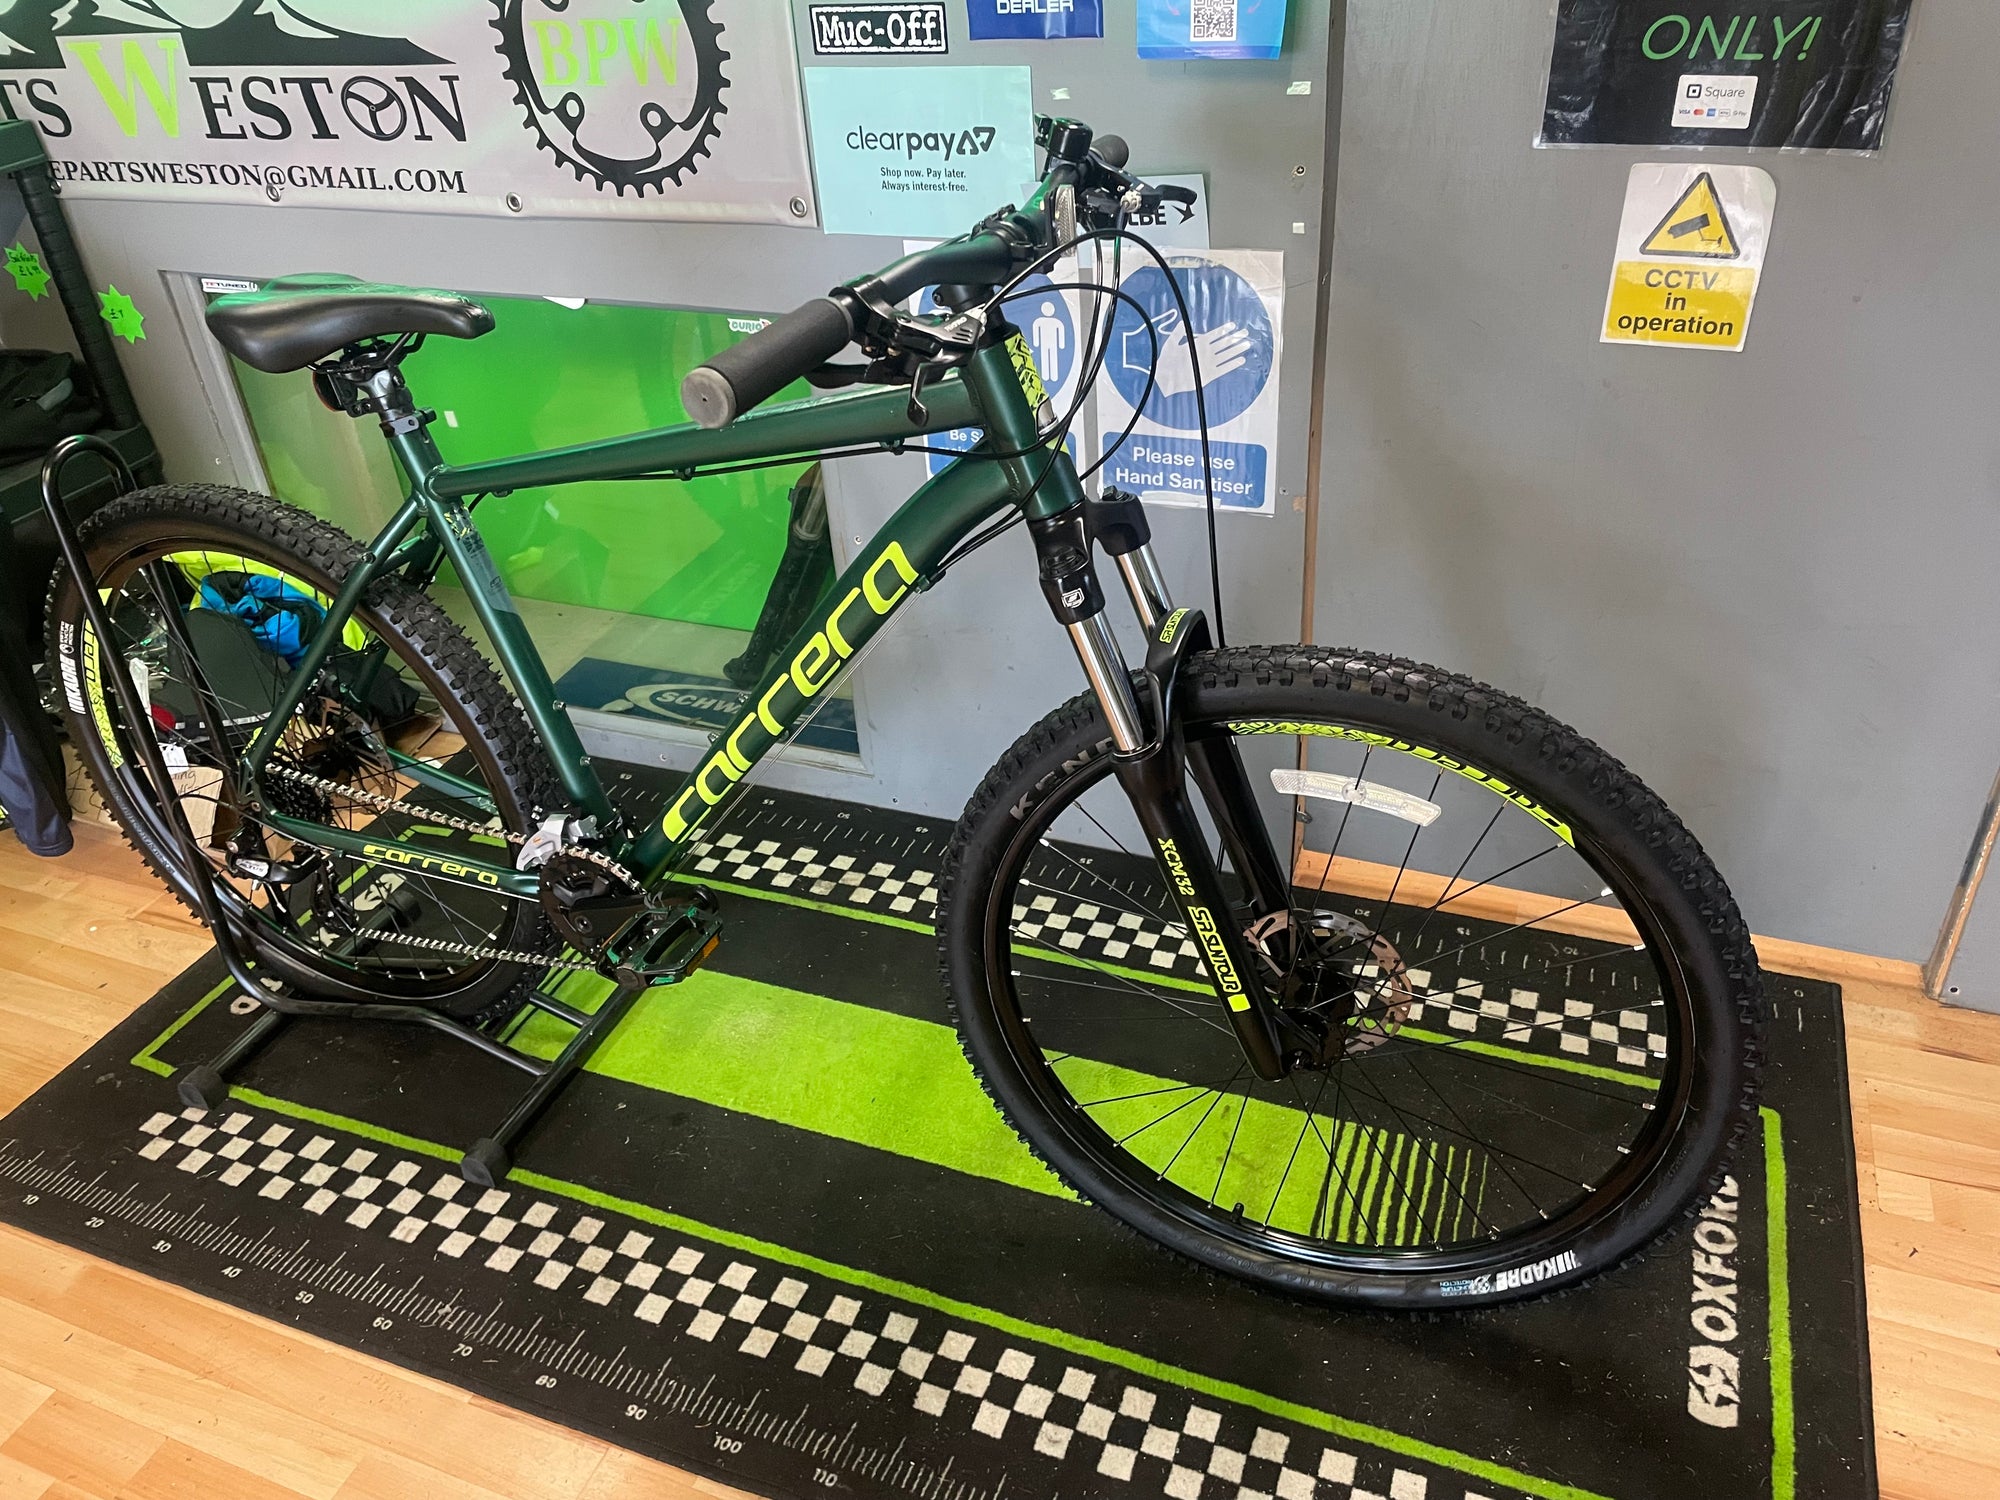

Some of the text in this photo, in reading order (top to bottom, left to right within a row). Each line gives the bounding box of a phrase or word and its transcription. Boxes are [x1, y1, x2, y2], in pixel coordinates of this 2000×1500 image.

[996, 0, 1074, 14] DEALER
[819, 11, 937, 47] Muc-Off
[1641, 14, 1823, 61] ONLY!
[529, 18, 681, 87] BPW
[1704, 86, 1746, 99] Square
[846, 125, 956, 161] clearpay
[880, 167, 967, 180] Shop now. Pay later.
[882, 180, 968, 192] Always interest-free.
[1645, 269, 1719, 290] CCTV
[1665, 292, 1687, 311] in
[1618, 314, 1733, 336] operation
[949, 430, 968, 442] Be
[1133, 446, 1195, 467] Please
[1116, 467, 1254, 496] Hand Santiser
[662, 541, 919, 844] carrera
[363, 844, 499, 886] carrera
[1157, 838, 1196, 896] XCM32
[22, 1194, 39, 1205] 10
[85, 1217, 104, 1228] 20
[152, 1240, 171, 1253] 30
[221, 1266, 242, 1278] 40
[295, 1290, 314, 1304] 50
[372, 1317, 392, 1331] 60
[452, 1343, 473, 1357] 70
[535, 1374, 557, 1389] 80
[625, 1404, 647, 1421] 90
[713, 1435, 743, 1454] 100
[813, 1467, 838, 1487] 110
